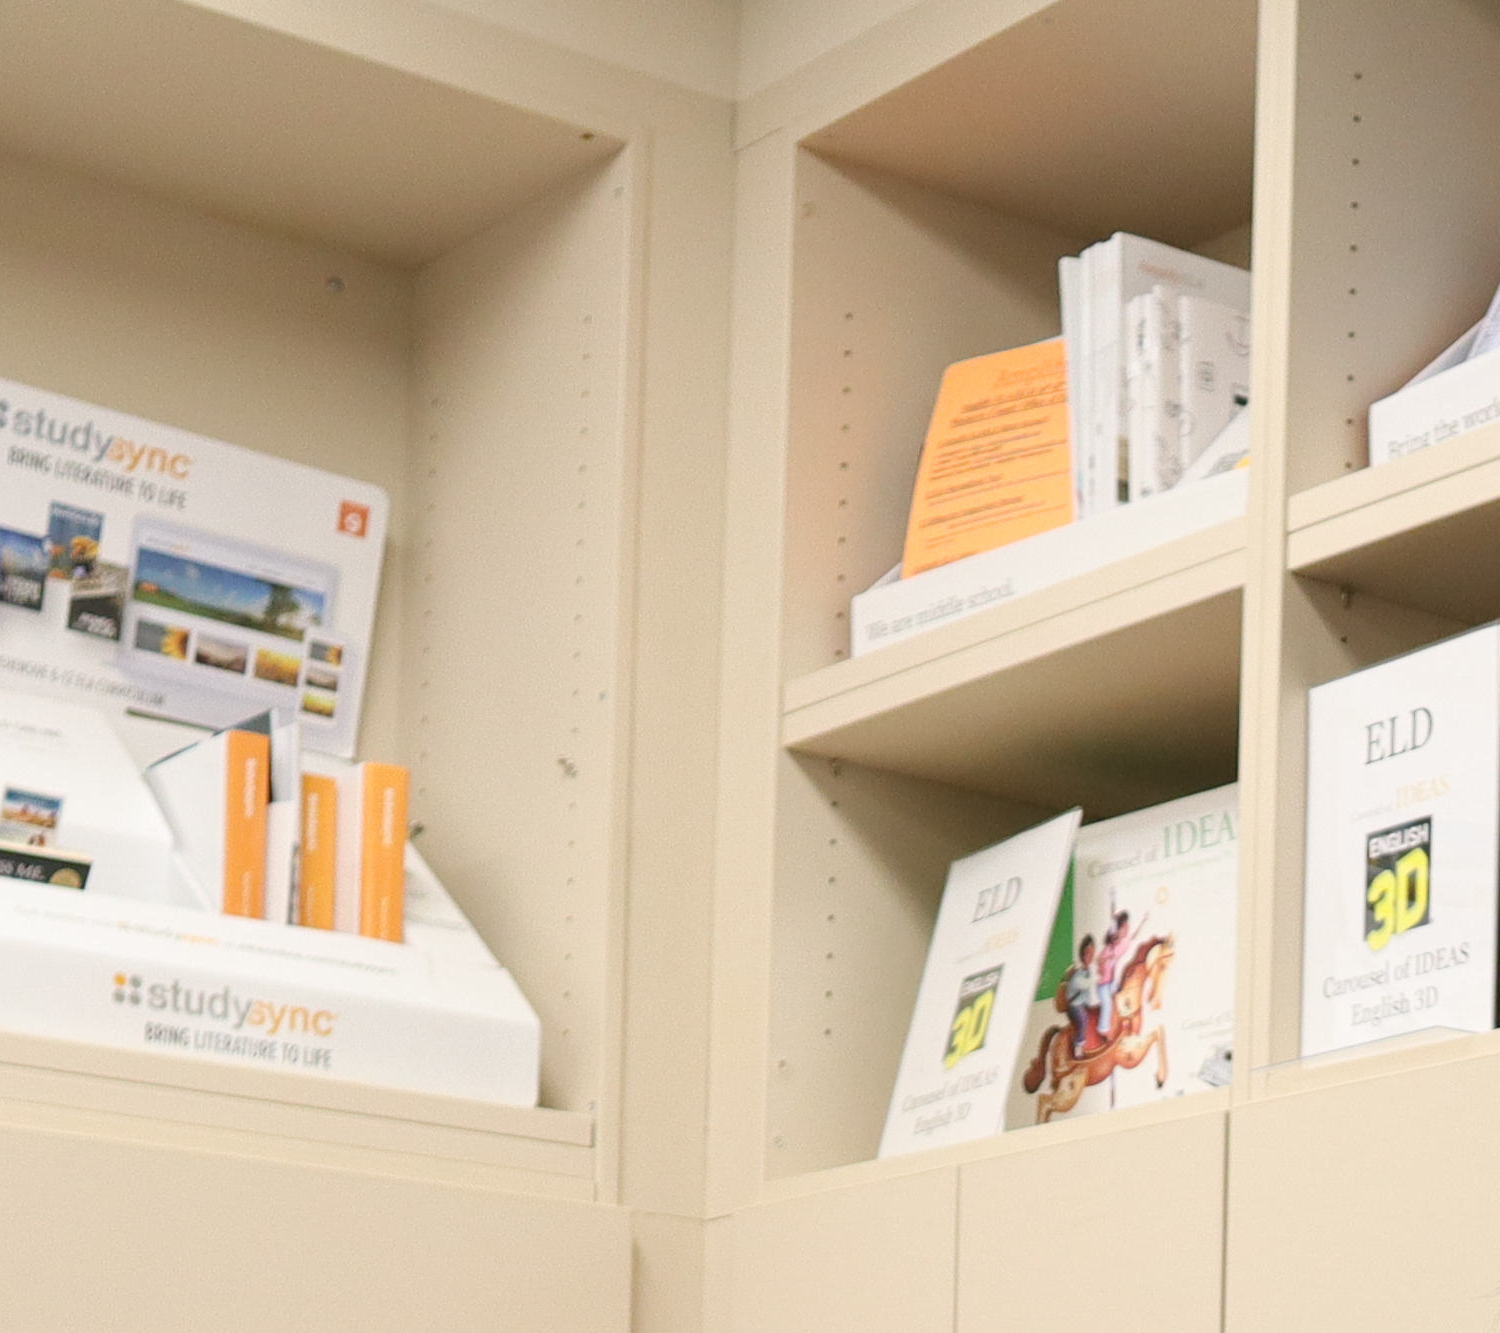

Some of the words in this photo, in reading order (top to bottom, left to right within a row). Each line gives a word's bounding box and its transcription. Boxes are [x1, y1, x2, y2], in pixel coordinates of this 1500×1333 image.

[13, 408, 192, 480] studysync
[1364, 706, 1434, 766] ELD
[1162, 809, 1238, 860] IDEA
[1368, 821, 1429, 860] ENGLISH
[971, 875, 1023, 924] ELD
[1366, 846, 1429, 952] 3D
[1322, 960, 1391, 999] Carousel
[1393, 953, 1411, 981] of
[1413, 942, 1471, 977] IDEAS
[147, 977, 336, 1038] studysync
[1351, 993, 1411, 1026] English
[1415, 985, 1439, 1012] 3D
[144, 1021, 190, 1048] BRING
[193, 1027, 278, 1063] LITERATURE
[281, 1042, 299, 1065] TO
[302, 1047, 334, 1070] LIFE
